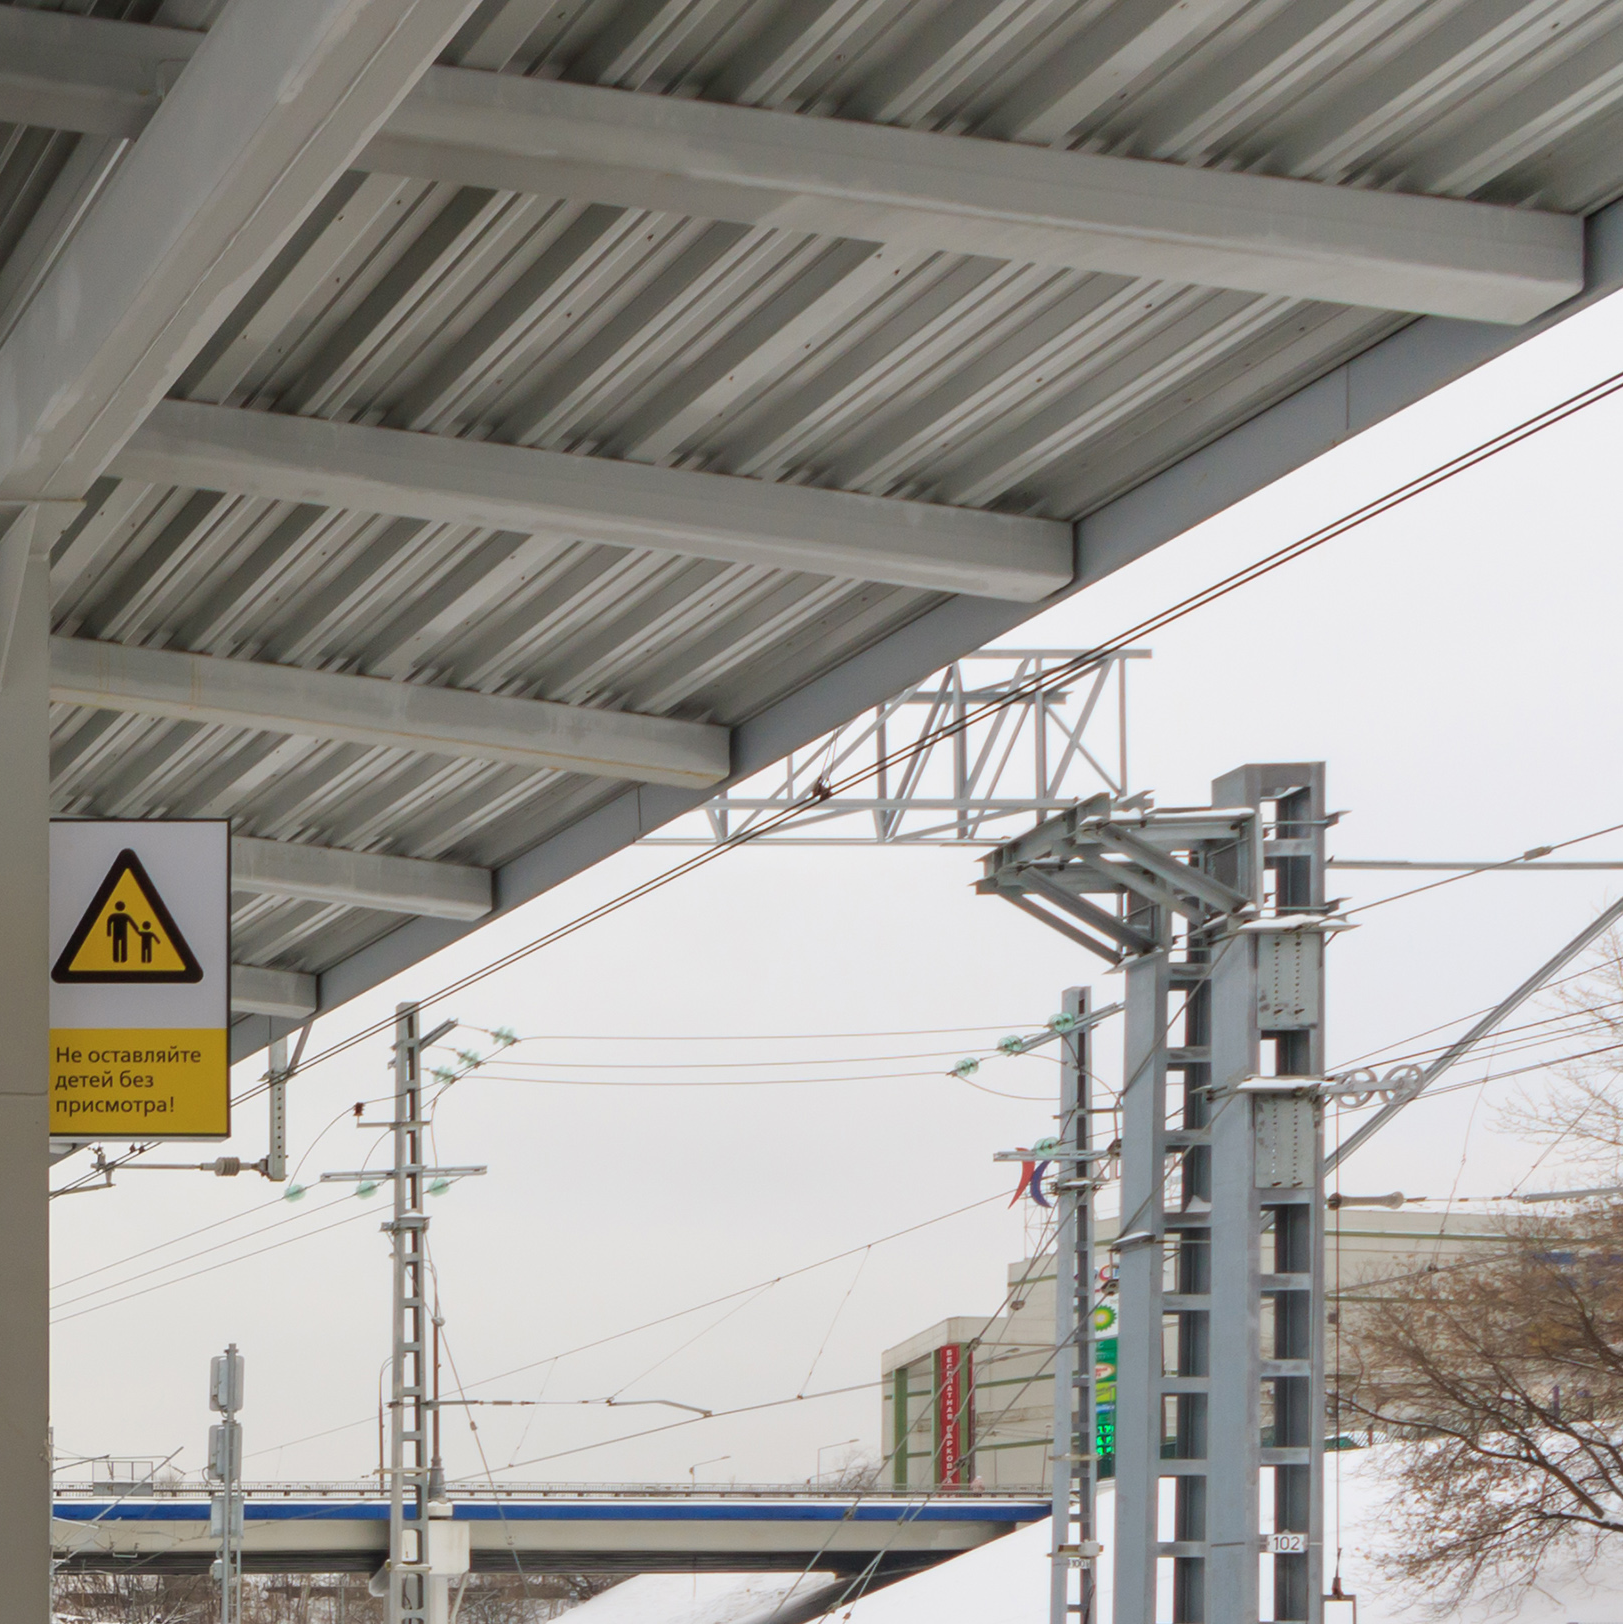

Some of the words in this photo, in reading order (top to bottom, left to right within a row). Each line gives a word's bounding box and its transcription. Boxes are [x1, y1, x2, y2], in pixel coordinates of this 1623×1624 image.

[55, 1047, 82, 1063] Не
[88, 1045, 201, 1063] оставляйте
[55, 1070, 113, 1090] детей
[119, 1070, 154, 1088] без
[55, 1096, 174, 1117] присмотра!
[1273, 1537, 1300, 1550] 102
